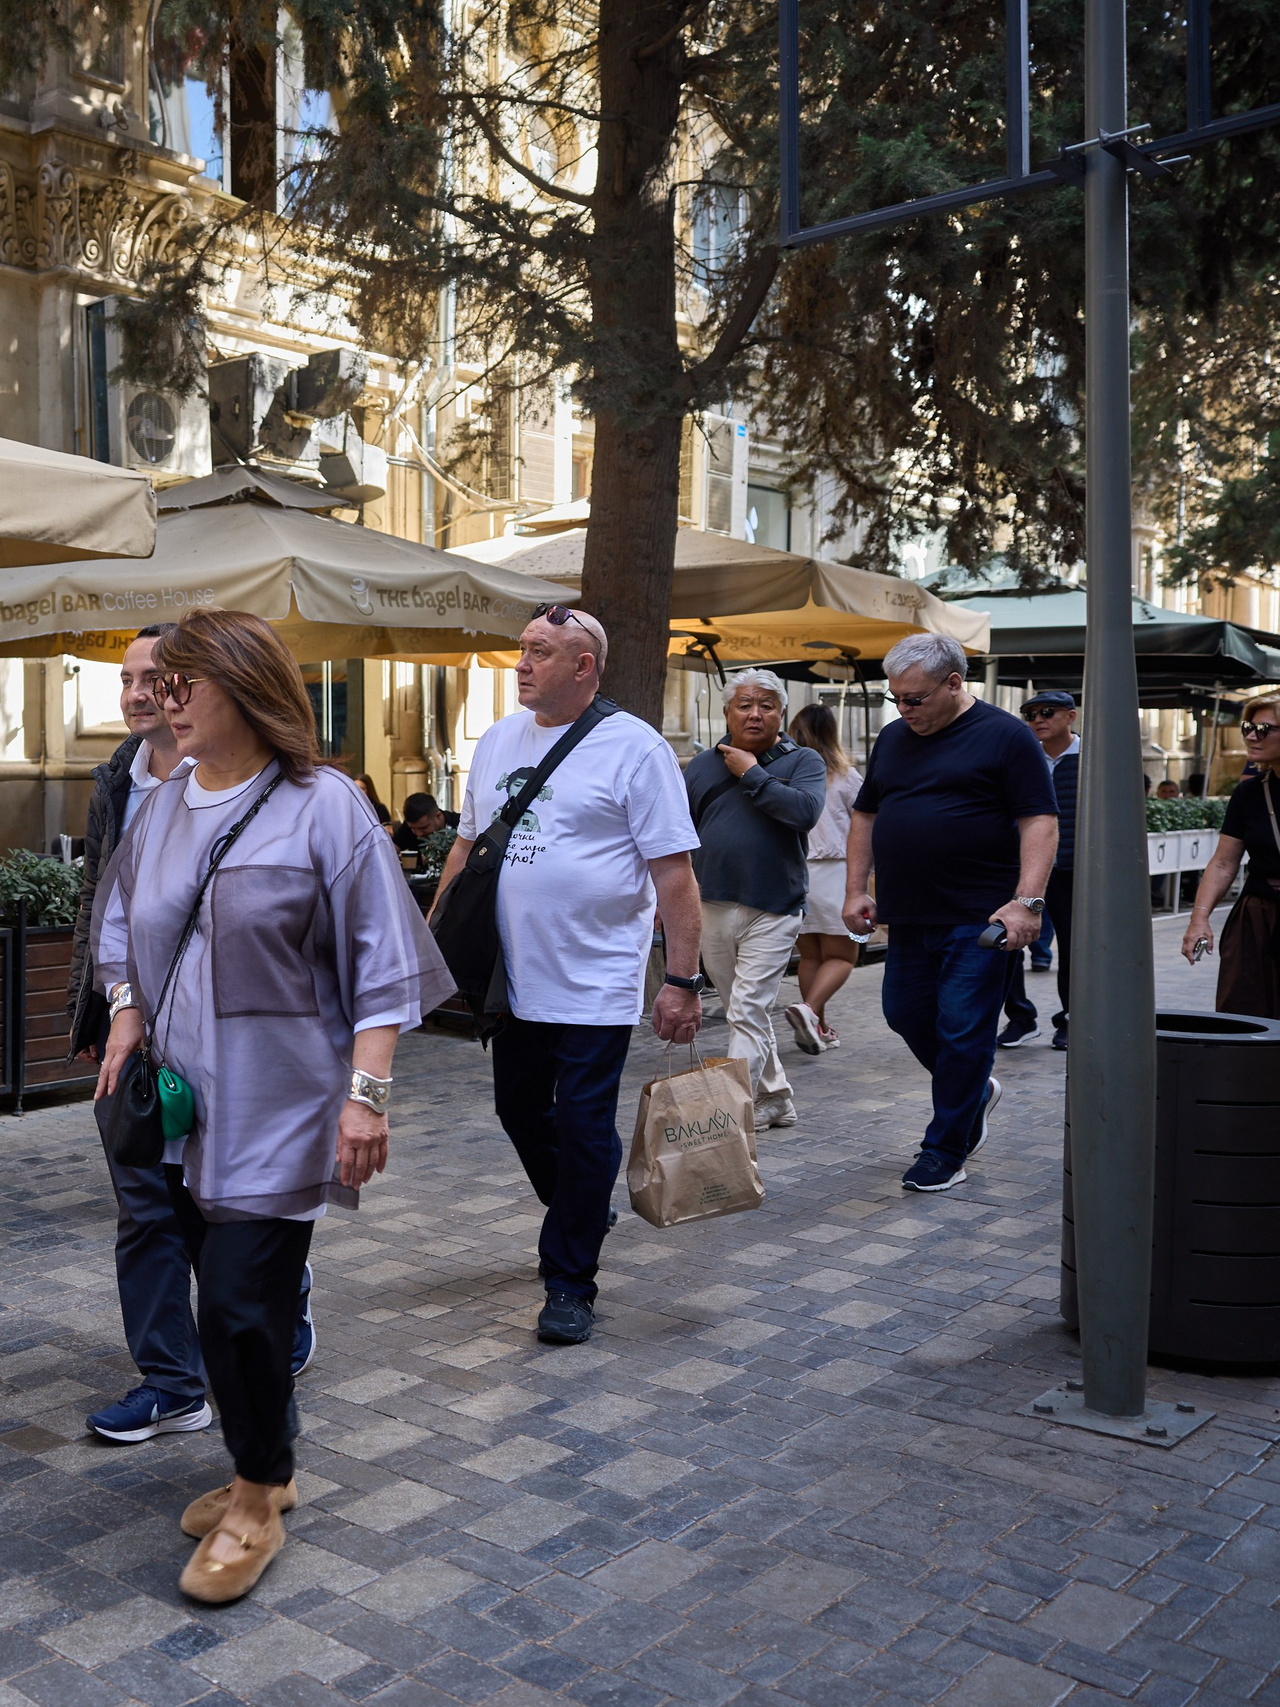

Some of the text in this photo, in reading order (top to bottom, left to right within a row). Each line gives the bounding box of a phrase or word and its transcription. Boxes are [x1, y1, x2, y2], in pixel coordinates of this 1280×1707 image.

[0, 592, 56, 625] bagel
[63, 593, 102, 613] BAR
[102, 590, 157, 612] Coffee
[162, 588, 216, 607] House
[376, 585, 531, 622] THE bagel BAR Coffee
[520, 844, 547, 852] мне
[664, 1108, 737, 1143] BAKLAVA
[683, 1131, 729, 1149] SWEET HOME
